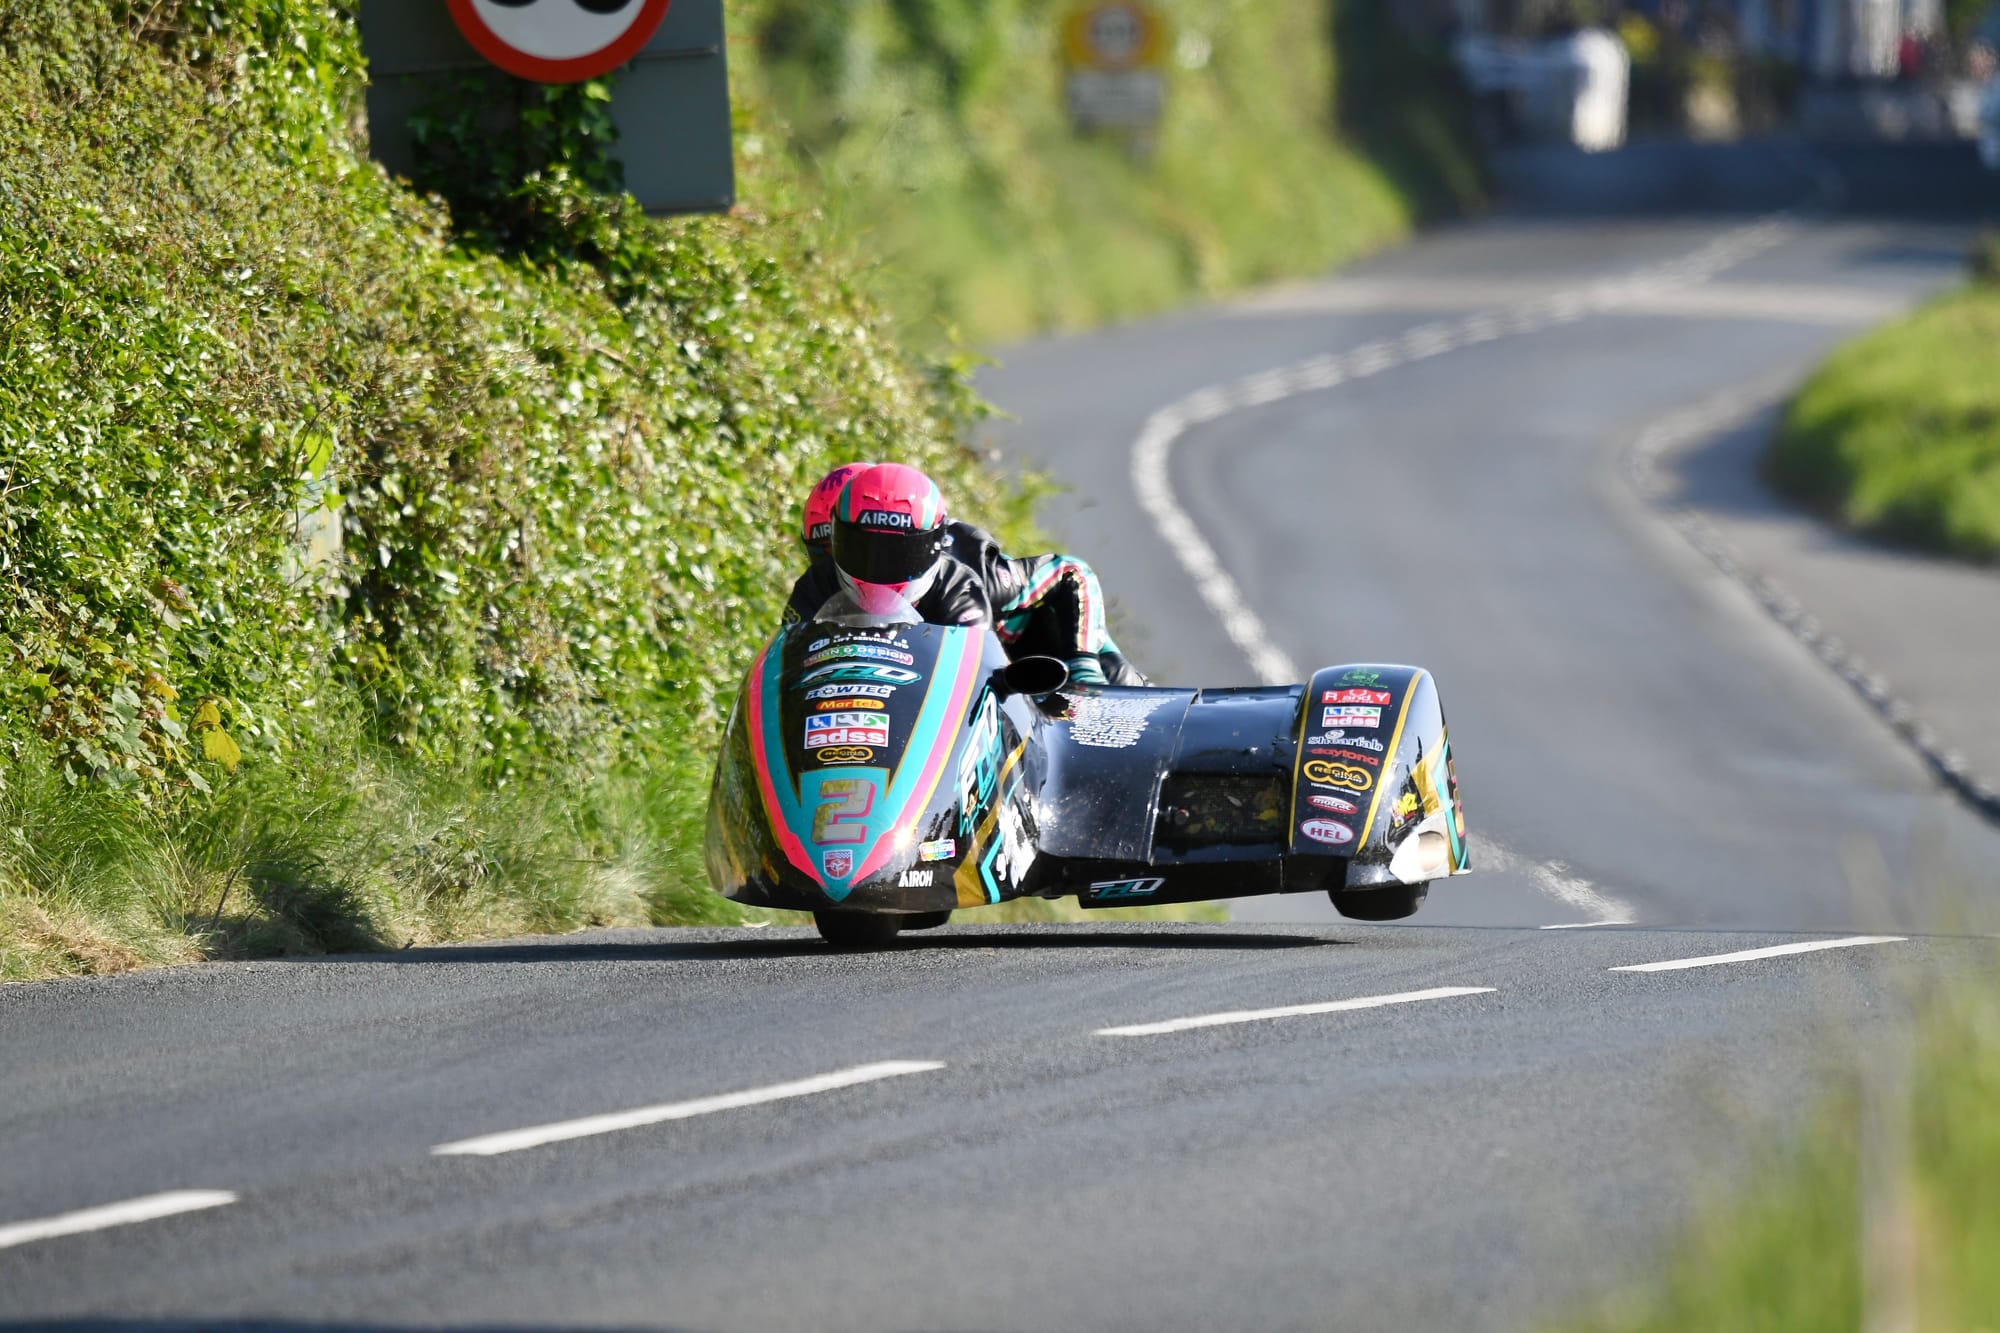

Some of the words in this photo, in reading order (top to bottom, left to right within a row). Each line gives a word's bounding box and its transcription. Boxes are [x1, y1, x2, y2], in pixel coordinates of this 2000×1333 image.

[860, 511, 912, 528] AIROH
[811, 524, 832, 540] AIR
[808, 729, 886, 746] adss
[1309, 748, 1379, 767] daytona
[1313, 766, 1363, 781] REGINA
[812, 780, 874, 844] 2
[1310, 827, 1344, 841] HEL
[898, 870, 933, 888] AIROH
